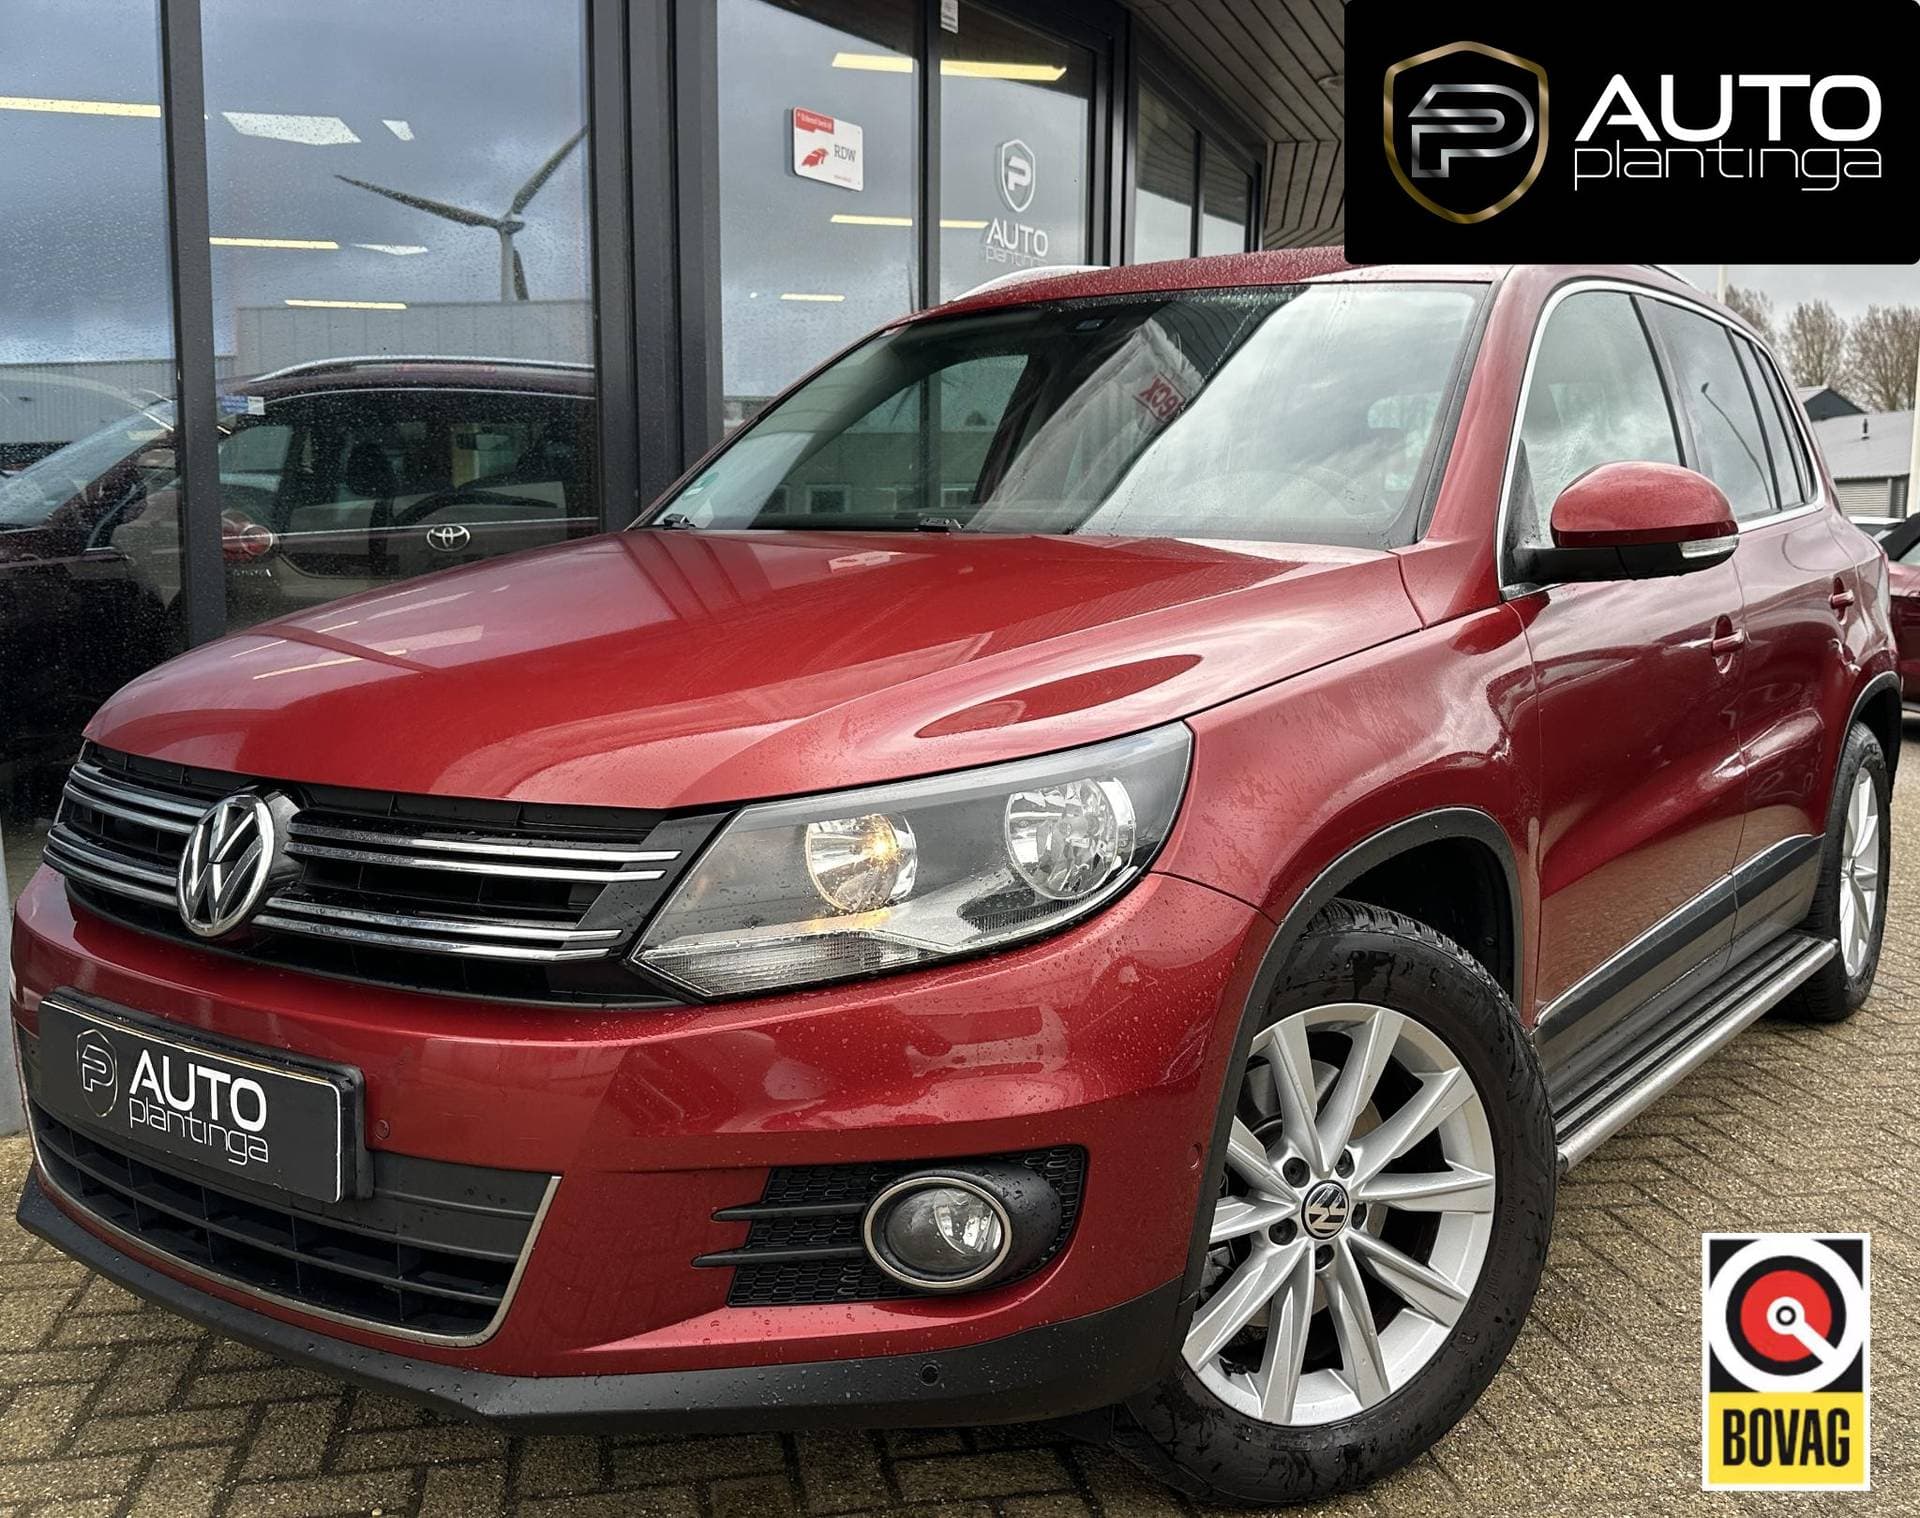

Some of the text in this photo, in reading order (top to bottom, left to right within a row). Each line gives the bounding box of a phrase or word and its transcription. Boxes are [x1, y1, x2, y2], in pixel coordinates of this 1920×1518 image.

[833, 144, 857, 163] RDW
[986, 217, 1049, 257] AUTO
[129, 1050, 267, 1132] AUTO
[129, 1097, 269, 1165] plantinga
